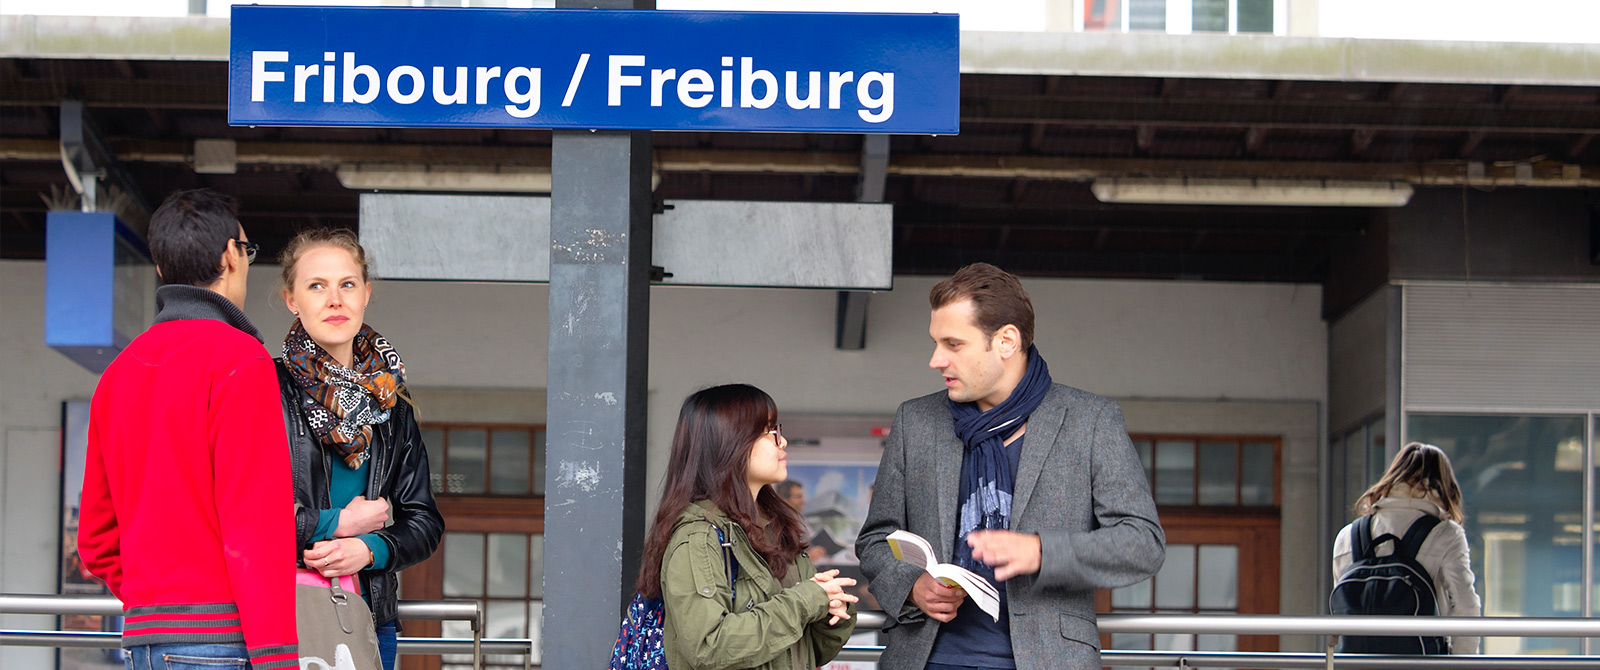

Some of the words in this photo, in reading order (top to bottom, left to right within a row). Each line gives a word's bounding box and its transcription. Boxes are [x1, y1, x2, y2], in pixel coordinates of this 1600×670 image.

[251, 50, 542, 118] Fribourg
[561, 53, 591, 107] /
[607, 54, 895, 124] Freiburg
